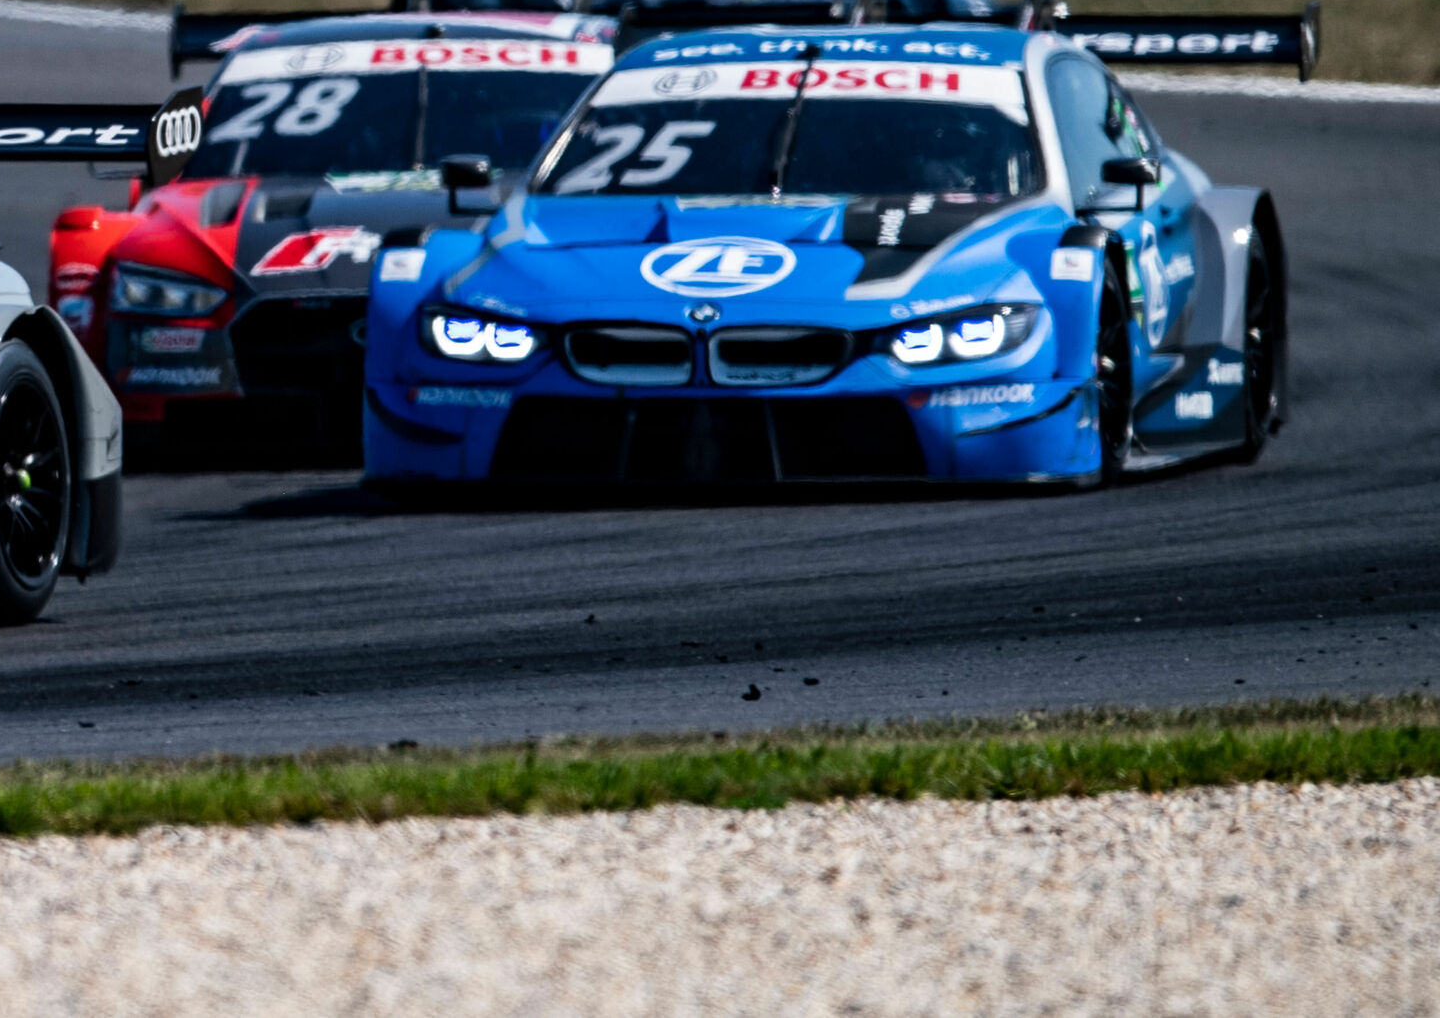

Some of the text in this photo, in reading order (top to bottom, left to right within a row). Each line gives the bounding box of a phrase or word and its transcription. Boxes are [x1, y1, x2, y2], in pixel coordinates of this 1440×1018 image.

[371, 44, 578, 66] BOSCH
[1073, 32, 1279, 55] rsport
[740, 68, 960, 92] BOSCH
[208, 79, 360, 144] 28
[555, 120, 716, 195] 25
